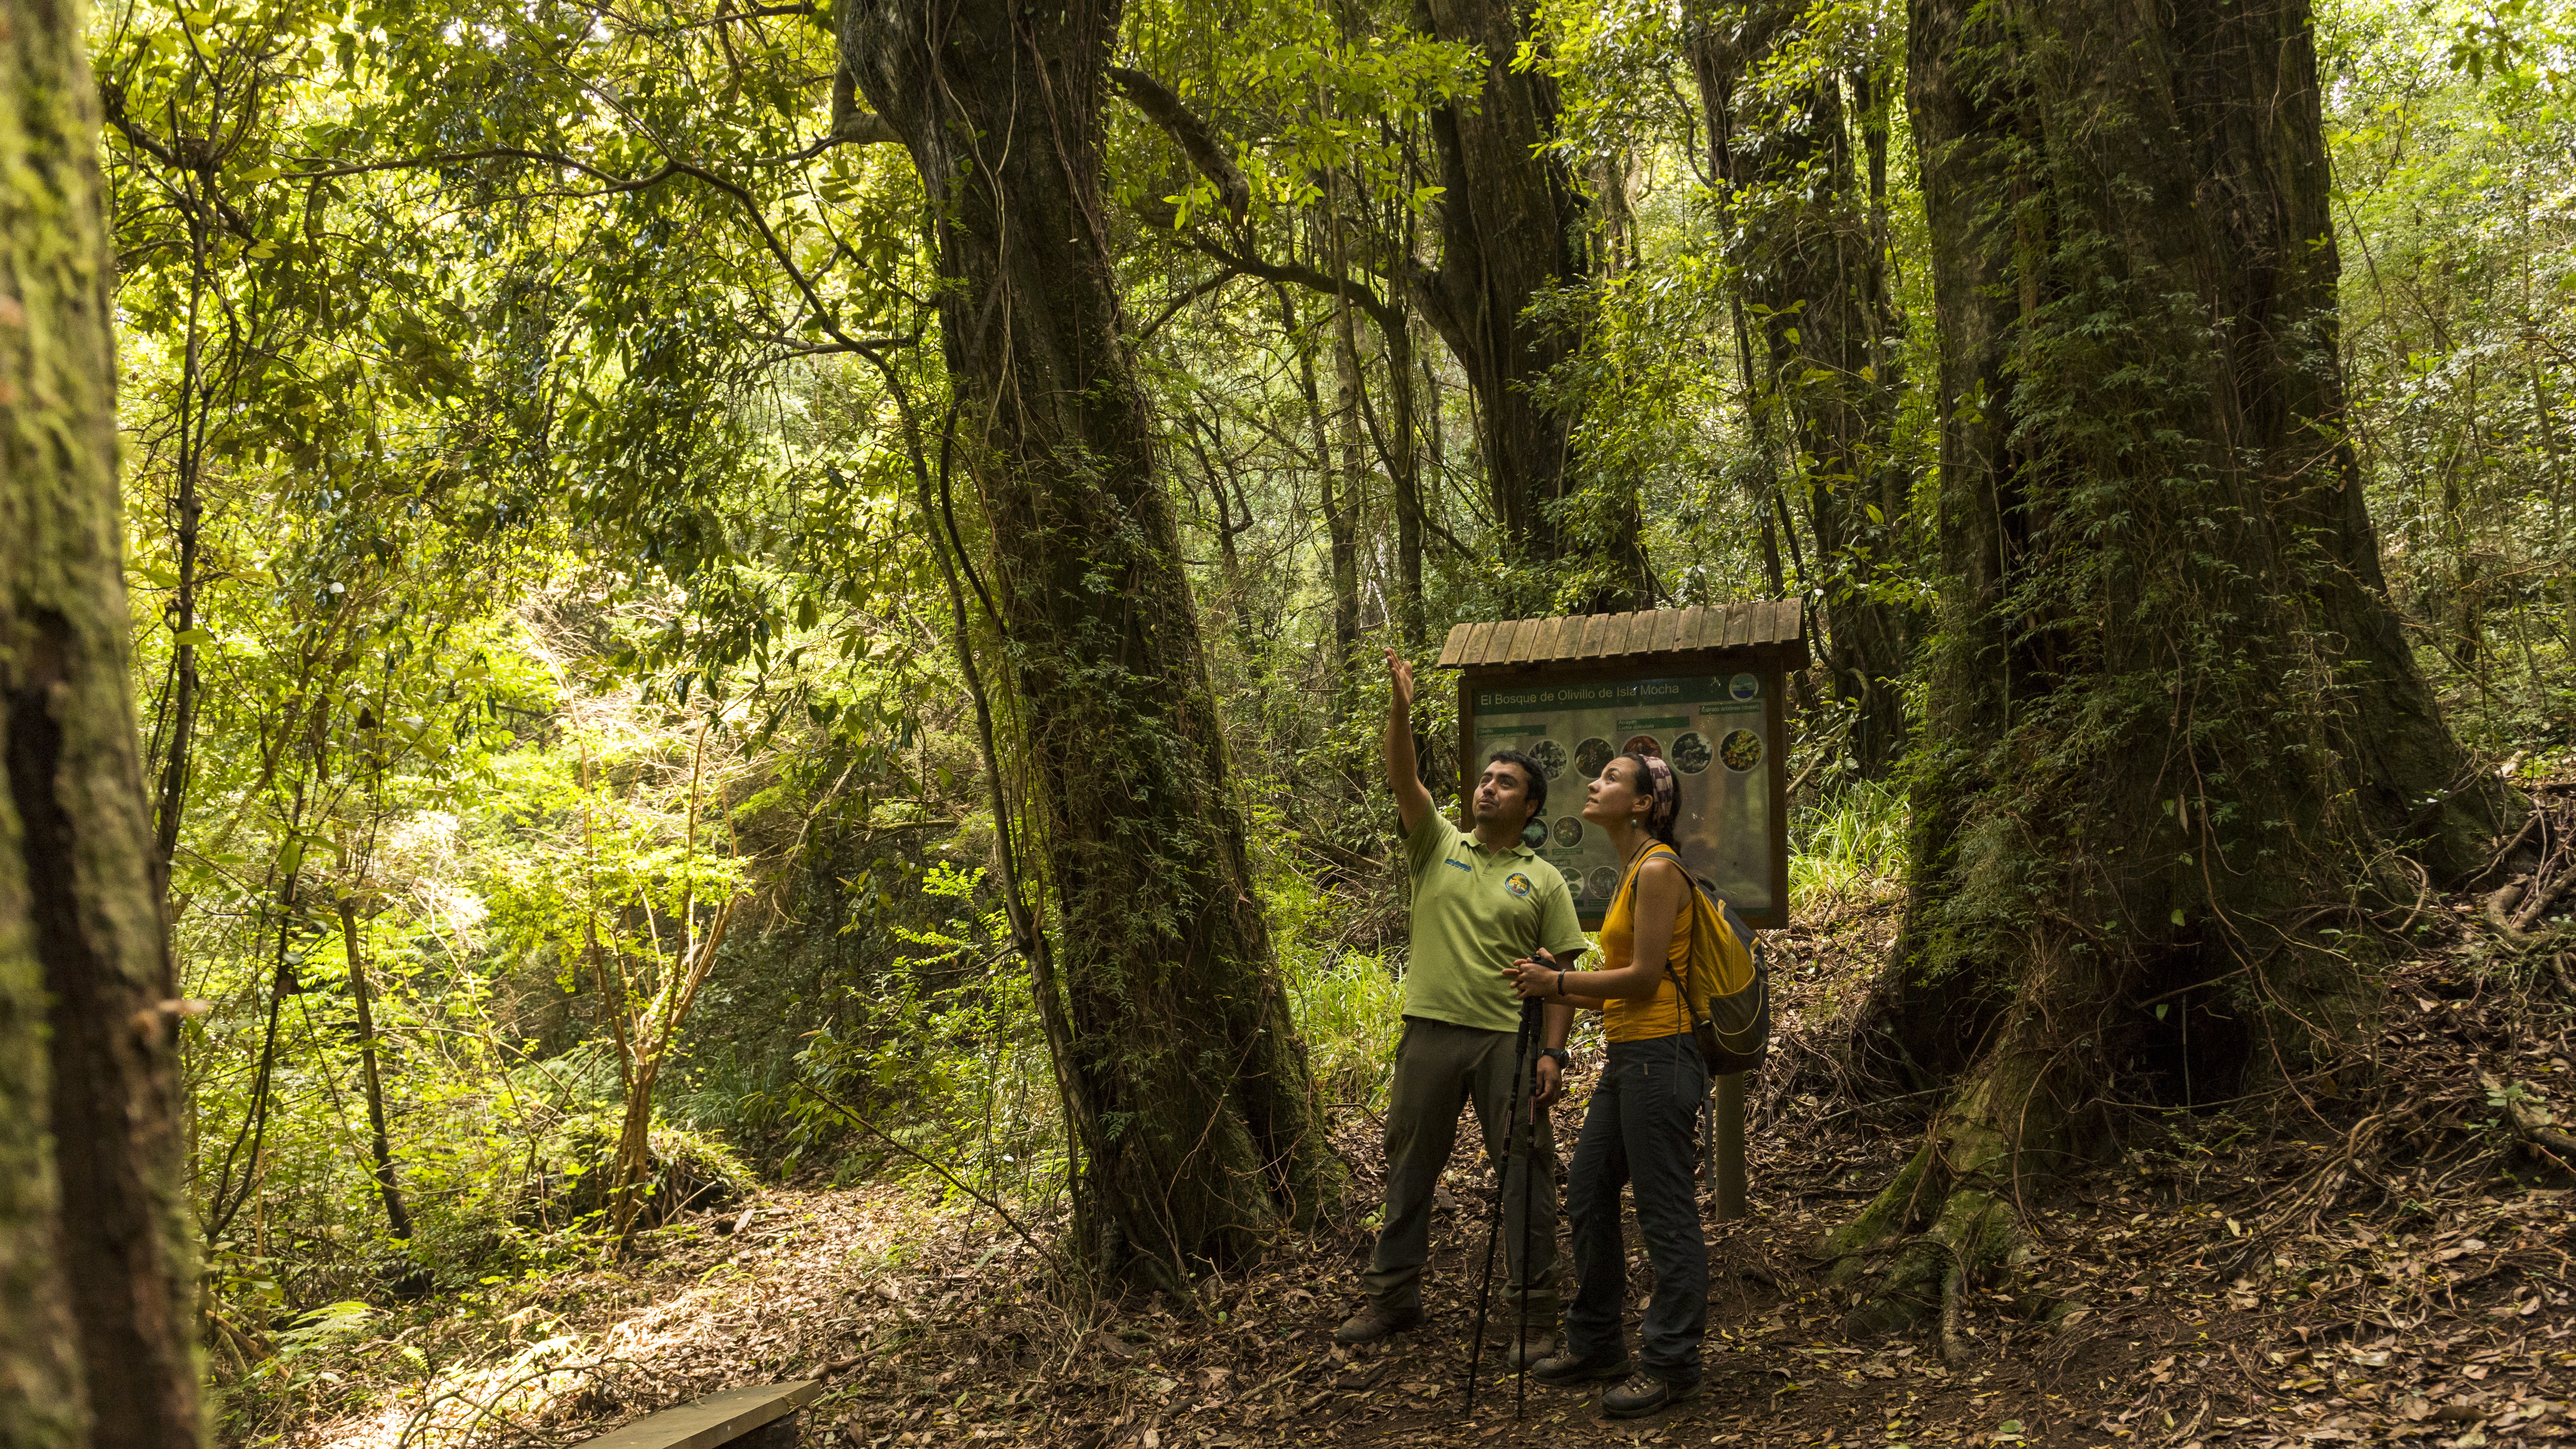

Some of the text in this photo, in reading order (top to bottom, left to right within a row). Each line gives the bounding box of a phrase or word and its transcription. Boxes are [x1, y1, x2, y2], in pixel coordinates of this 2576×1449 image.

[1481, 683, 1679, 705] El Bosque de Olivillo de Isla Mocha
